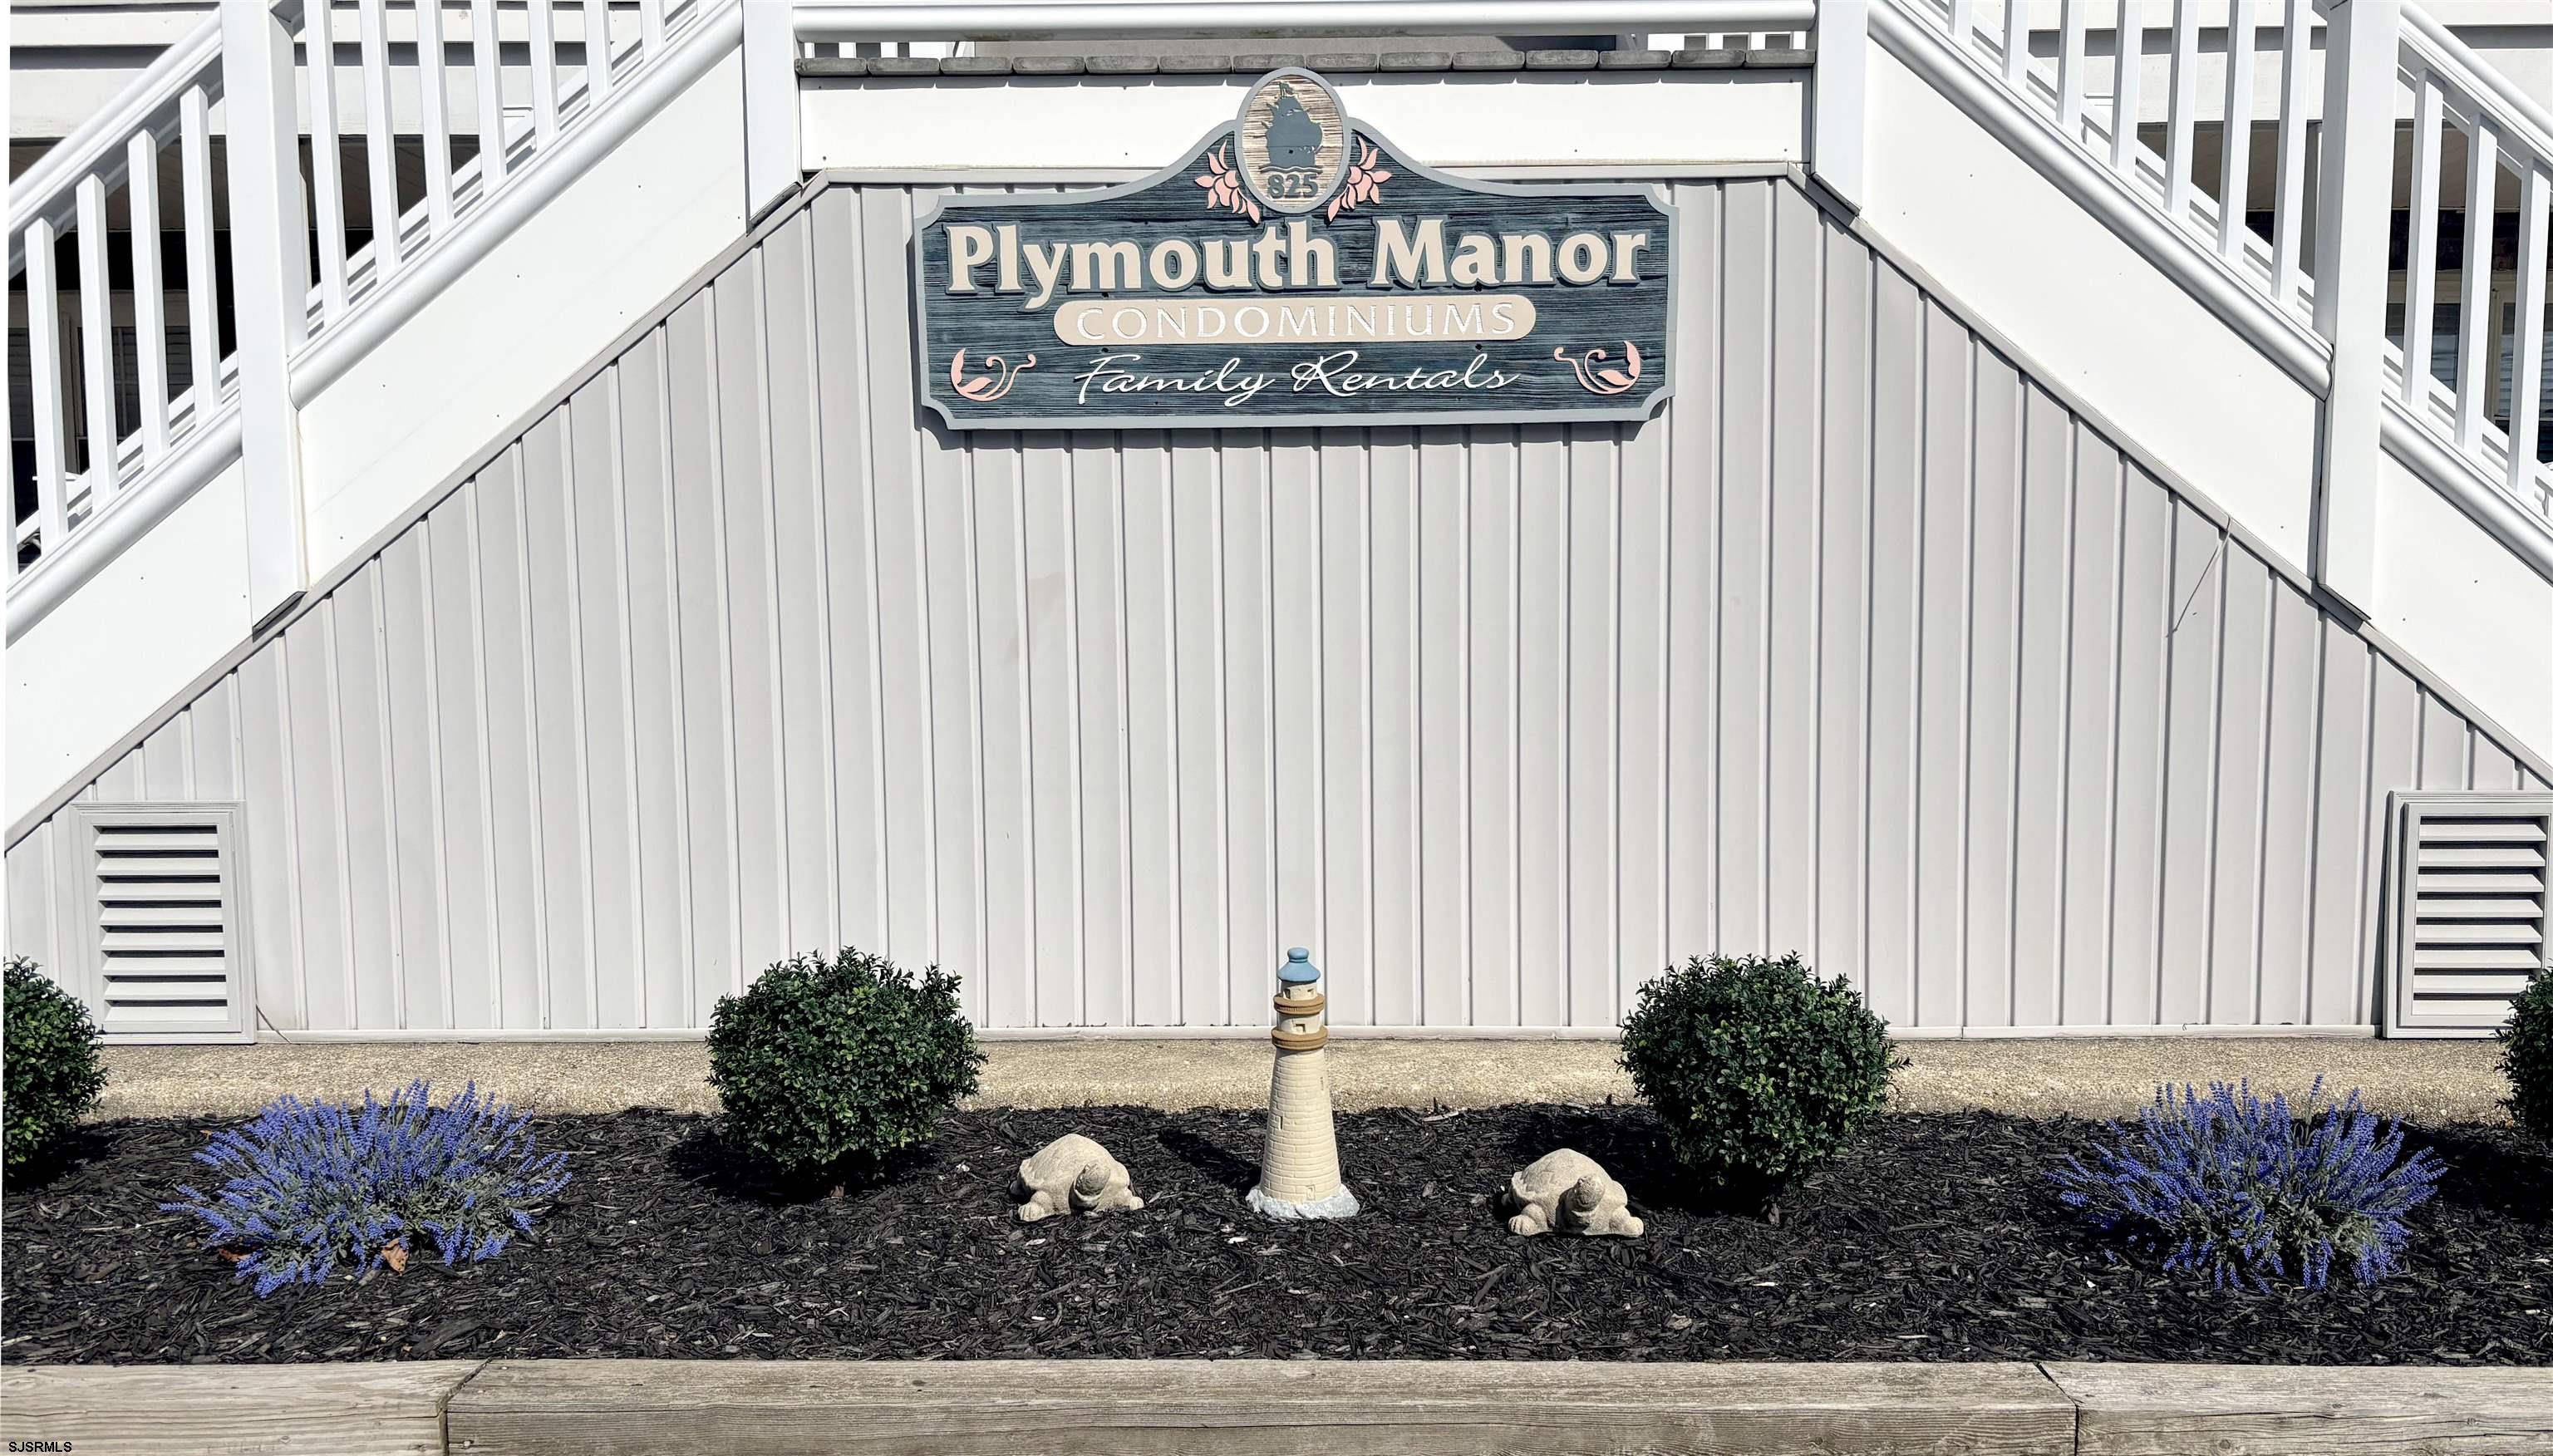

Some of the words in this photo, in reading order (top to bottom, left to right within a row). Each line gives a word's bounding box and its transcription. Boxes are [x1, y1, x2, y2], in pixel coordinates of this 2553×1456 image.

[1267, 174, 1319, 199] 825
[947, 219, 1337, 309] Plymouth
[1370, 219, 1648, 287] Manor
[1076, 303, 1516, 340] CONDOMINIUMS
[1074, 352, 1276, 406] Family
[1291, 350, 1521, 397] Rentals
